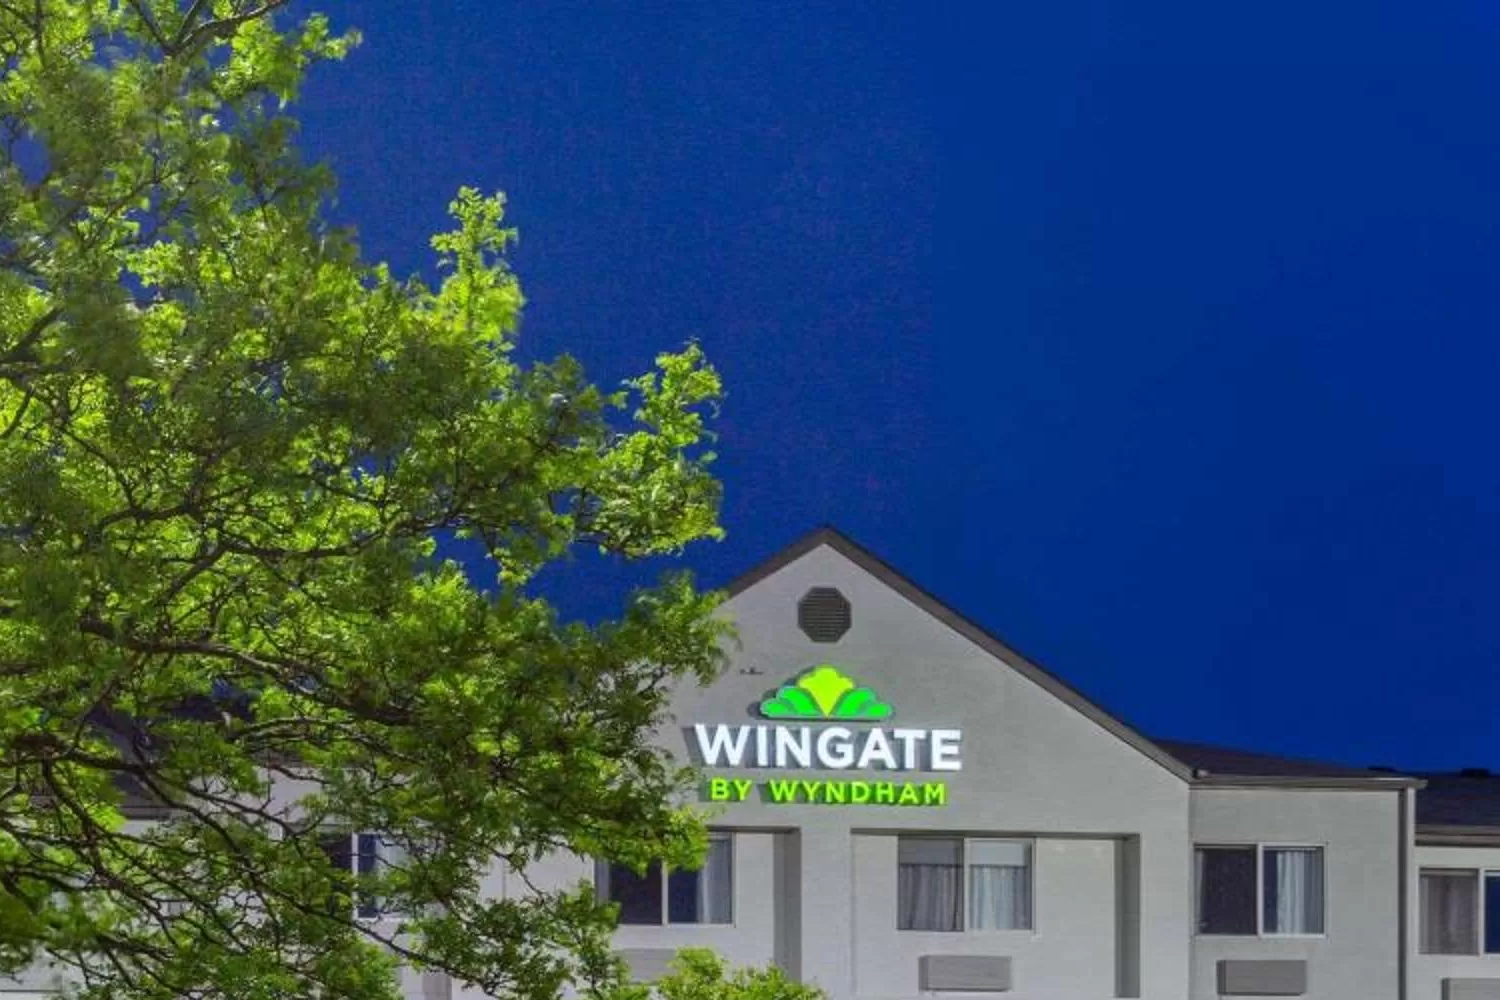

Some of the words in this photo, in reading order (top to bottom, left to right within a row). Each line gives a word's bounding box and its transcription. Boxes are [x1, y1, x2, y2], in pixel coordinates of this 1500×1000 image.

[695, 723, 963, 770] WINGATE
[711, 777, 751, 801] BY
[769, 778, 947, 804] WYNDHAM
